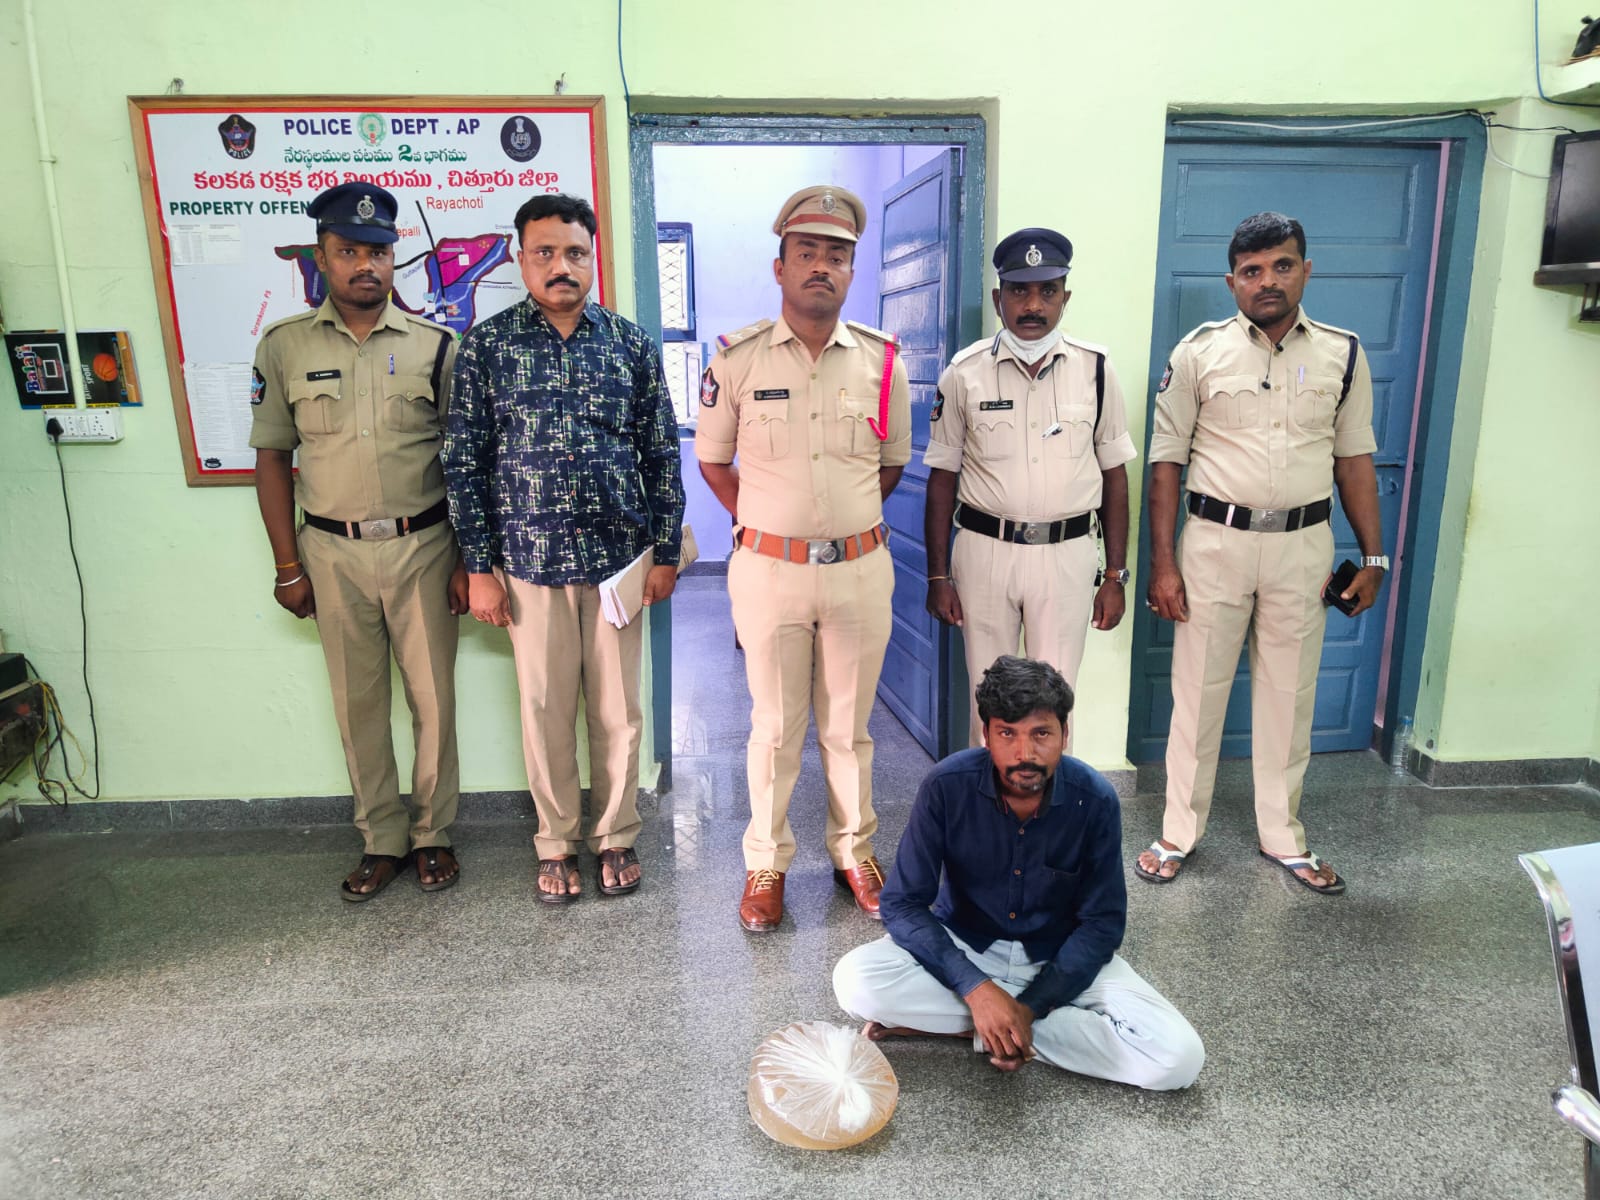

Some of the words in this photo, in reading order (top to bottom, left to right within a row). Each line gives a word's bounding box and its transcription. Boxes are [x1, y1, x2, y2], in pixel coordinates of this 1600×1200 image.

[283, 118, 353, 136] POLICE
[391, 118, 439, 135] DEPT
[457, 118, 481, 135] AP
[193, 170, 256, 190] కలకడ
[259, 170, 303, 196] రక్షక
[447, 169, 514, 193] చిత్తూరు
[518, 169, 559, 193] జిల్లా
[169, 201, 254, 216] PROPERTY
[259, 201, 311, 215] OFFEN
[426, 196, 483, 212] Rayachoti
[396, 226, 420, 239] epalli
[14, 345, 41, 393] Balaji
